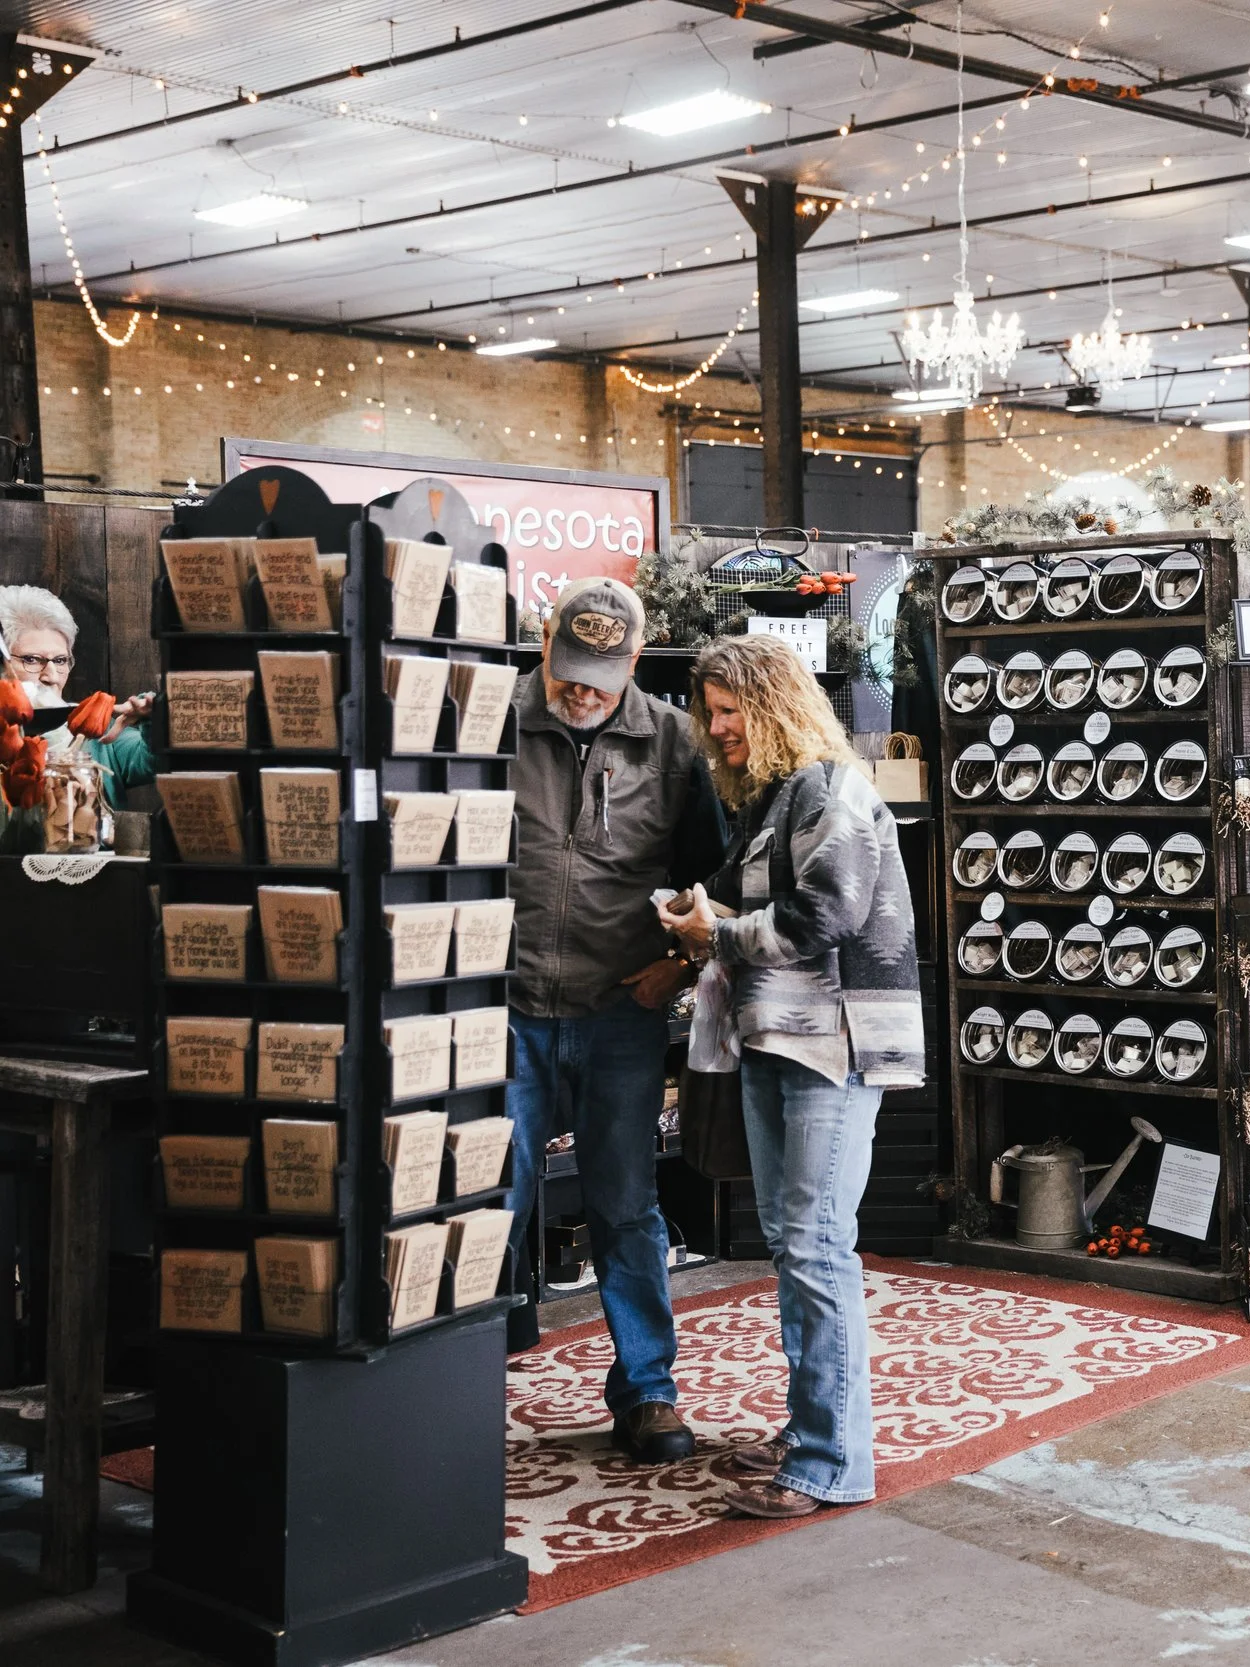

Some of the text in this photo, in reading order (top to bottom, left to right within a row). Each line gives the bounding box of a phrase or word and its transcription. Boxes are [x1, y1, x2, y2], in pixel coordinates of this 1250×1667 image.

[470, 503, 645, 559] nesota
[592, 622, 613, 635] DEER
[768, 623, 808, 635] FREE
[796, 642, 813, 652] NT
